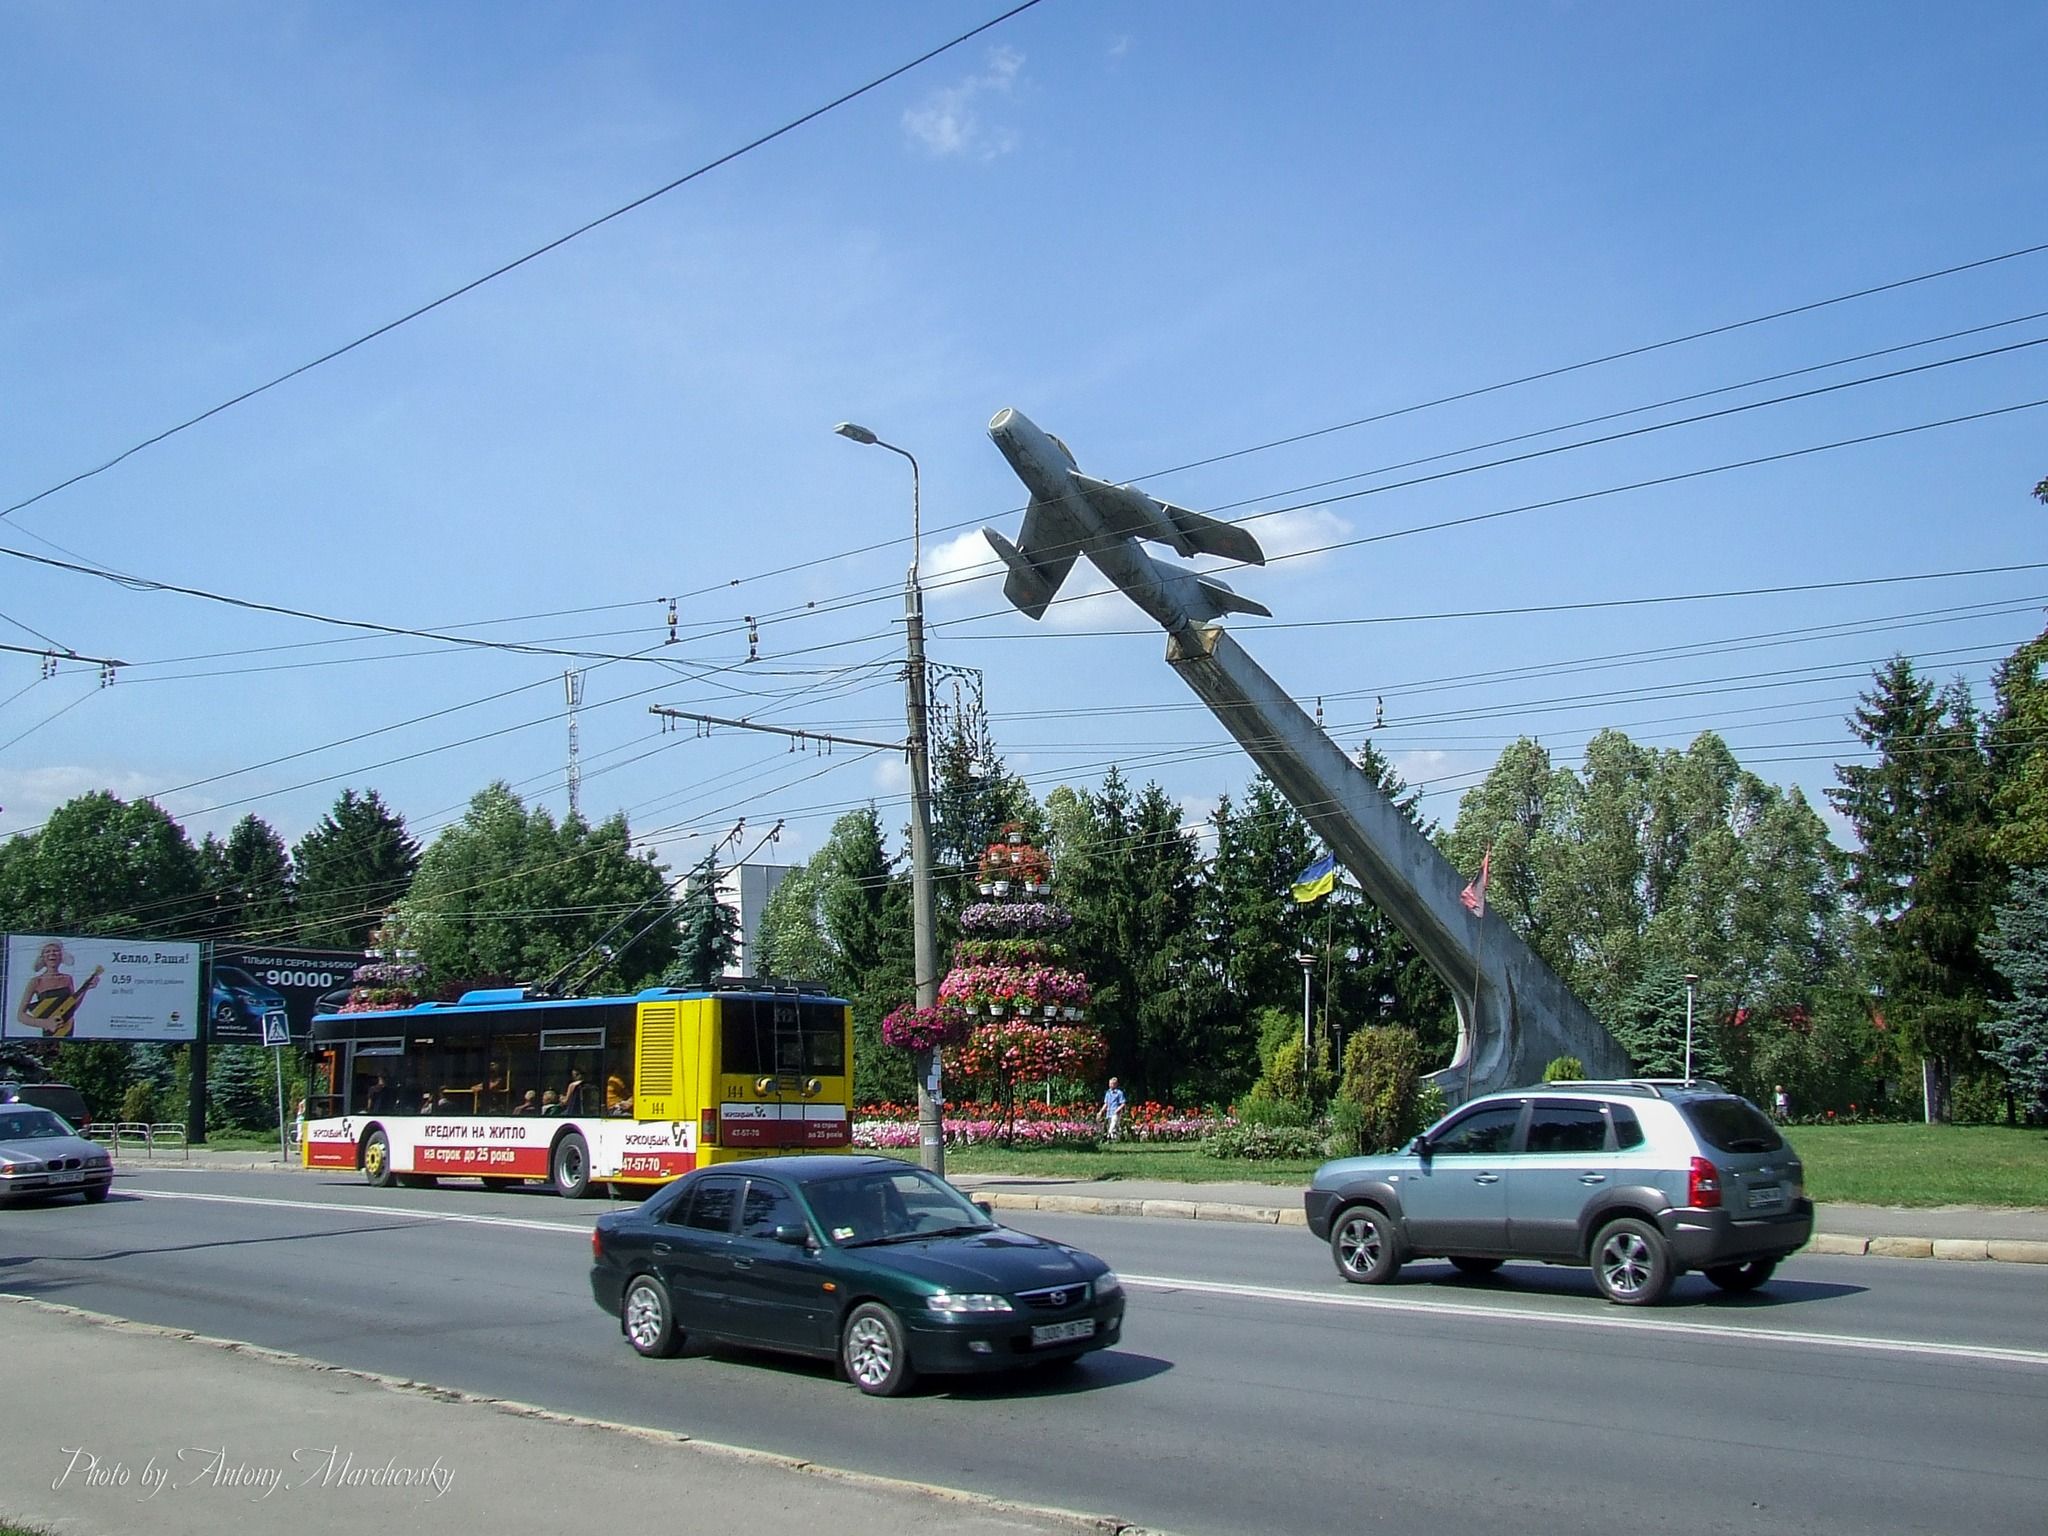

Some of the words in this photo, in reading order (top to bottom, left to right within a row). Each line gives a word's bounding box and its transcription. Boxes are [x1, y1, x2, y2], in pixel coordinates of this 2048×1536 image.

[112, 952, 151, 964] Хелло,
[154, 952, 189, 964] Раша!
[112, 975, 132, 985] 0,59
[266, 970, 333, 987] 90000
[727, 1085, 744, 1098] 144
[652, 1102, 664, 1115] 144
[424, 1125, 468, 1139] КРЕДИТИ
[472, 1126, 485, 1138] НА
[489, 1127, 526, 1139] ЖИТЛО
[817, 1130, 825, 1138] 25
[424, 1148, 435, 1160] на
[436, 1149, 461, 1163] строк
[464, 1149, 475, 1163] до
[476, 1148, 488, 1161] 25
[490, 1148, 515, 1164] років
